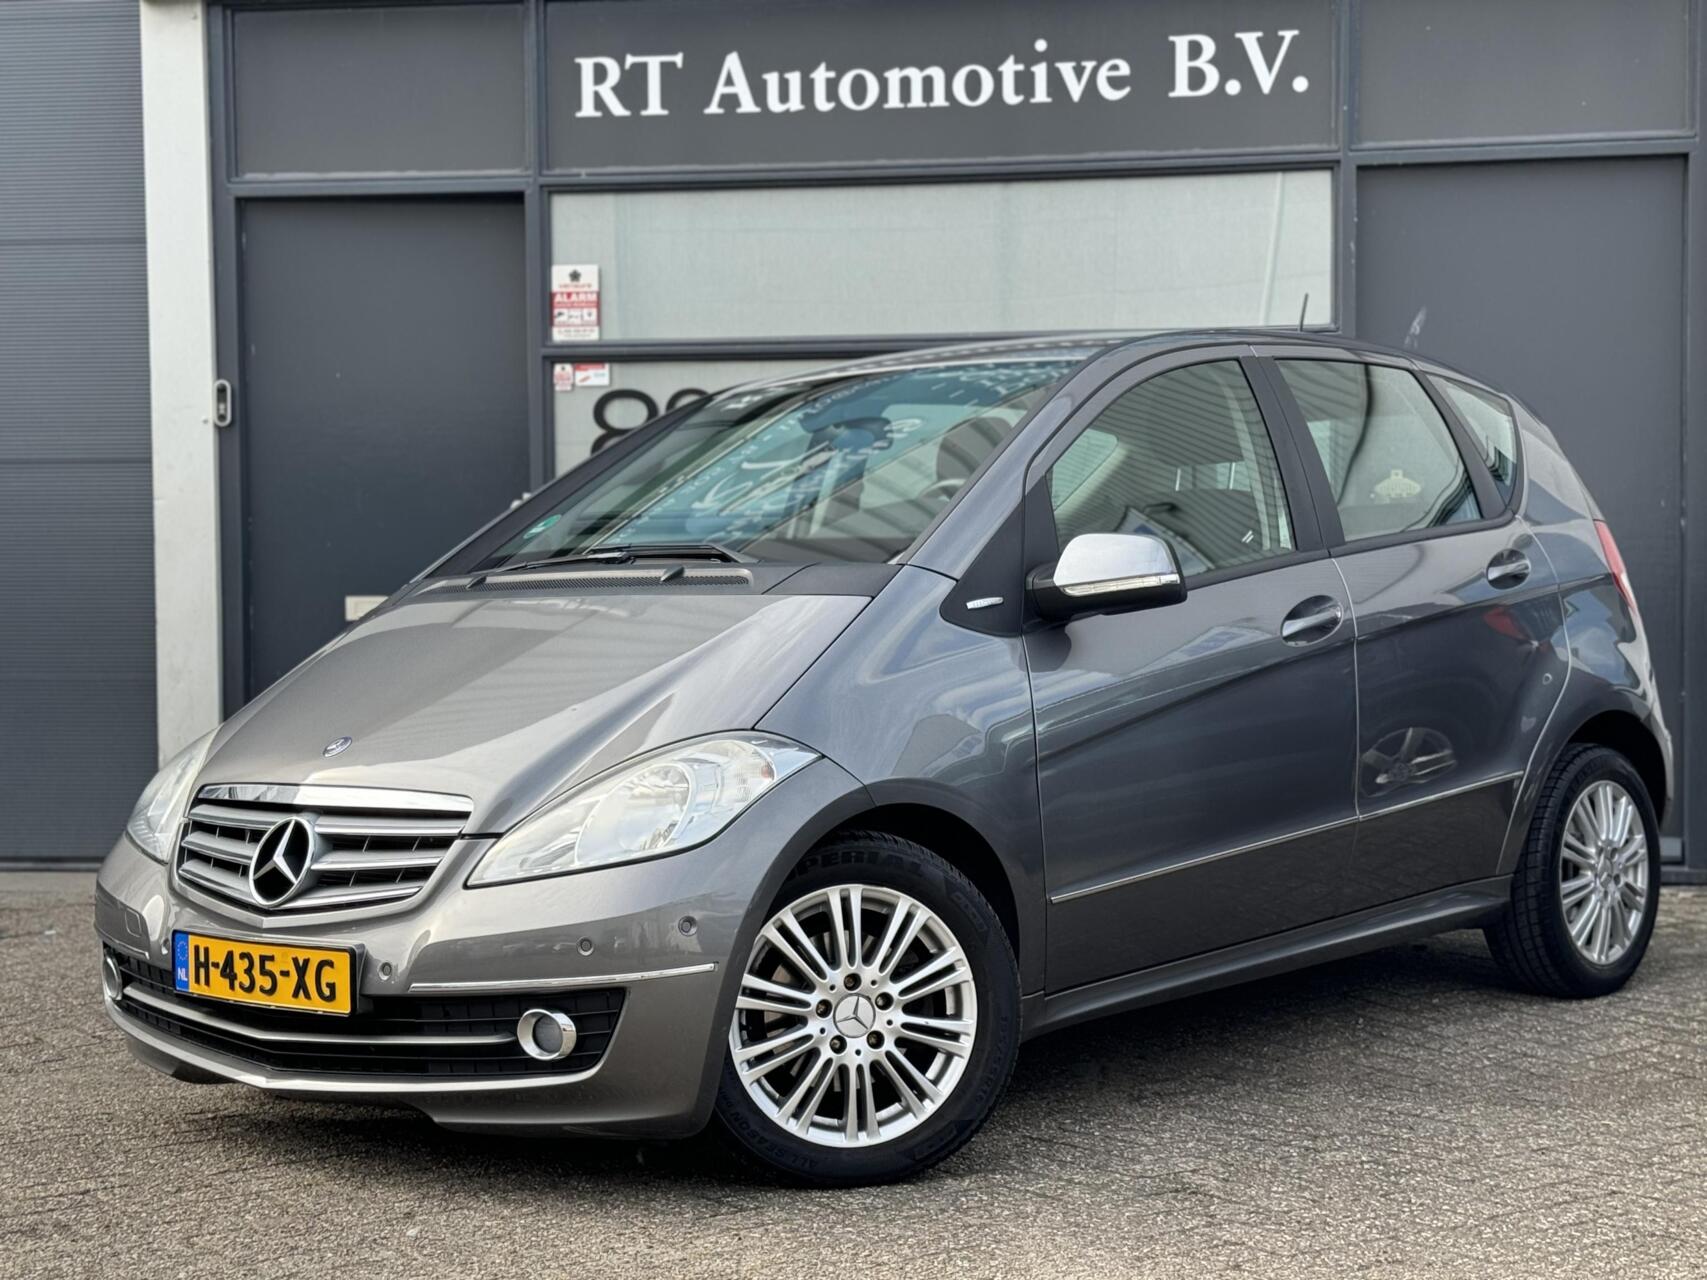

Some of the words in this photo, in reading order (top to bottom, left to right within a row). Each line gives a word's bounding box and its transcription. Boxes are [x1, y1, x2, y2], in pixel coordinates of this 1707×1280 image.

[574, 52, 684, 118] RT
[703, 38, 1131, 115] Automotive
[1168, 29, 1309, 98] B.V.
[554, 293, 597, 302] ALARM
[177, 967, 188, 982] NL
[193, 945, 337, 1002] H-435-XG
